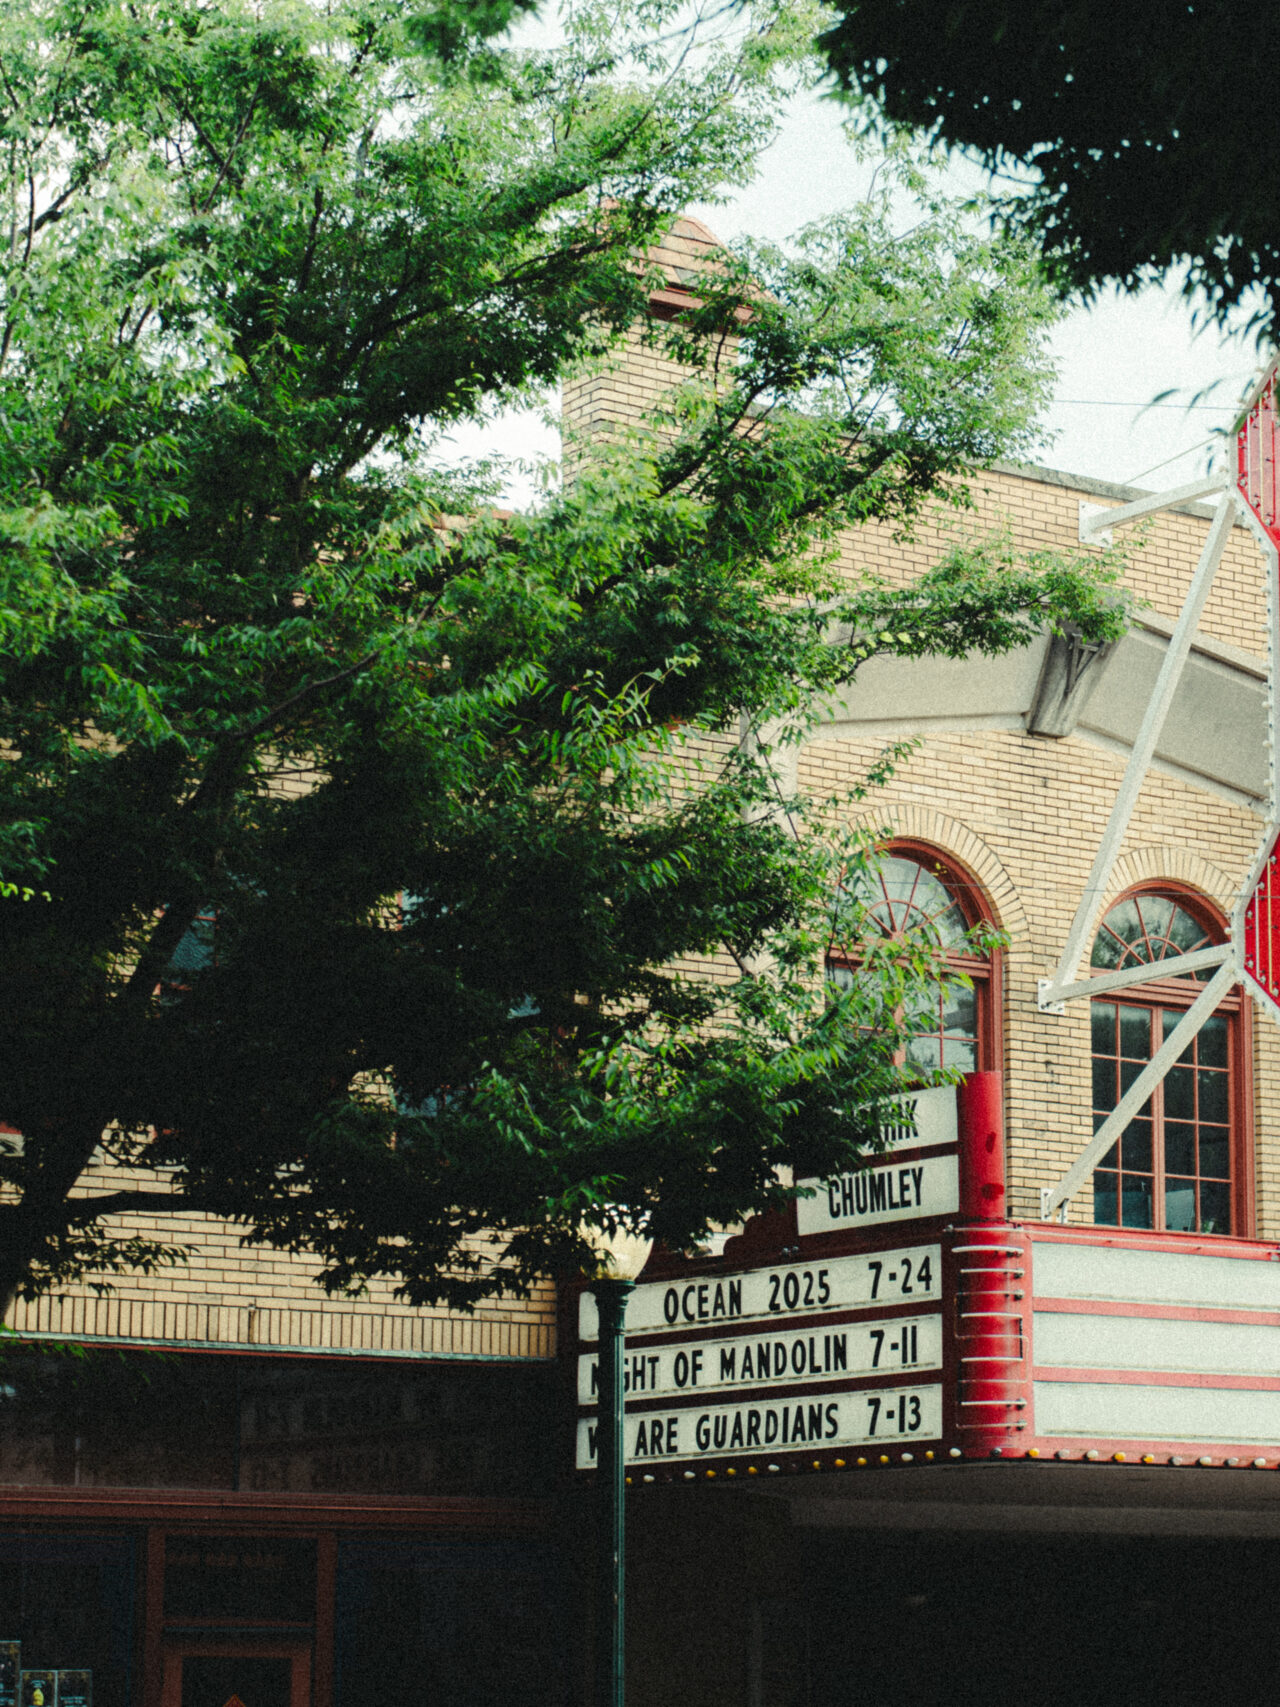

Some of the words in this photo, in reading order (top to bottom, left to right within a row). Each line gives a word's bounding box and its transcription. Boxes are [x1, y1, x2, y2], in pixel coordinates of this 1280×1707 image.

[828, 1166, 924, 1219] CHUMLEY
[664, 1279, 742, 1324] OCEAN
[769, 1269, 830, 1313] 2025
[868, 1255, 932, 1299] 7-24
[674, 1349, 703, 1388] OF
[720, 1334, 848, 1381] MANDOLIN
[870, 1325, 918, 1368] 7-11
[635, 1417, 678, 1456] ARE
[695, 1403, 839, 1451] GUARDIANS
[867, 1395, 922, 1436] 7-13
